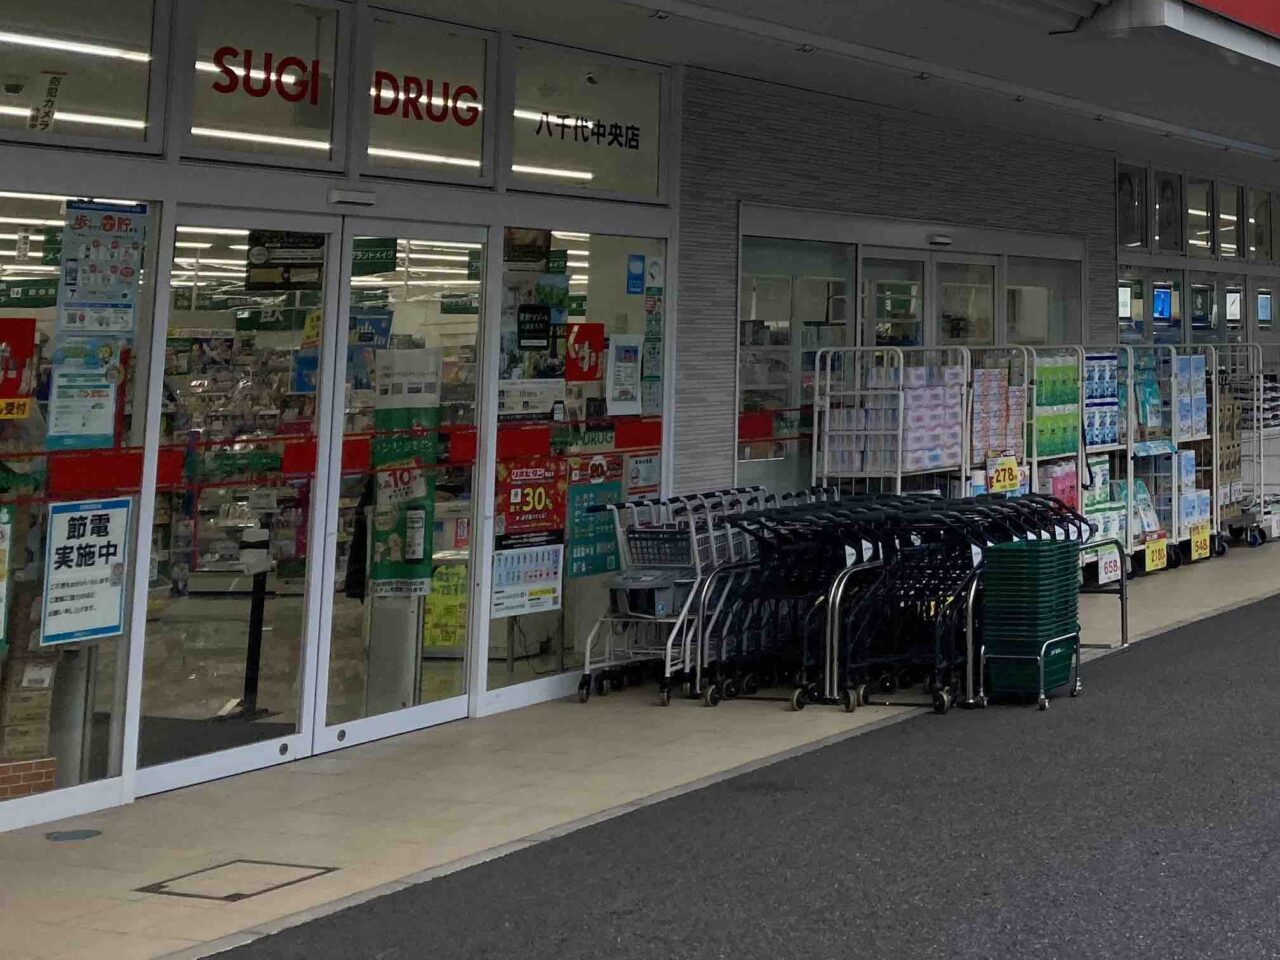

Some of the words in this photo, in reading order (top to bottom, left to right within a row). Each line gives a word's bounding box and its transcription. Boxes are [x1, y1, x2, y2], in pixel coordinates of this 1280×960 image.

[212, 46, 320, 105] SUGI
[373, 71, 480, 126] DRUG
[535, 111, 641, 151] 八千代中央店
[512, 470, 544, 480] リポビタン
[995, 467, 1014, 483] 278
[66, 513, 110, 540] 節電
[54, 540, 118, 570] 実施中
[1104, 559, 1118, 575] 658
